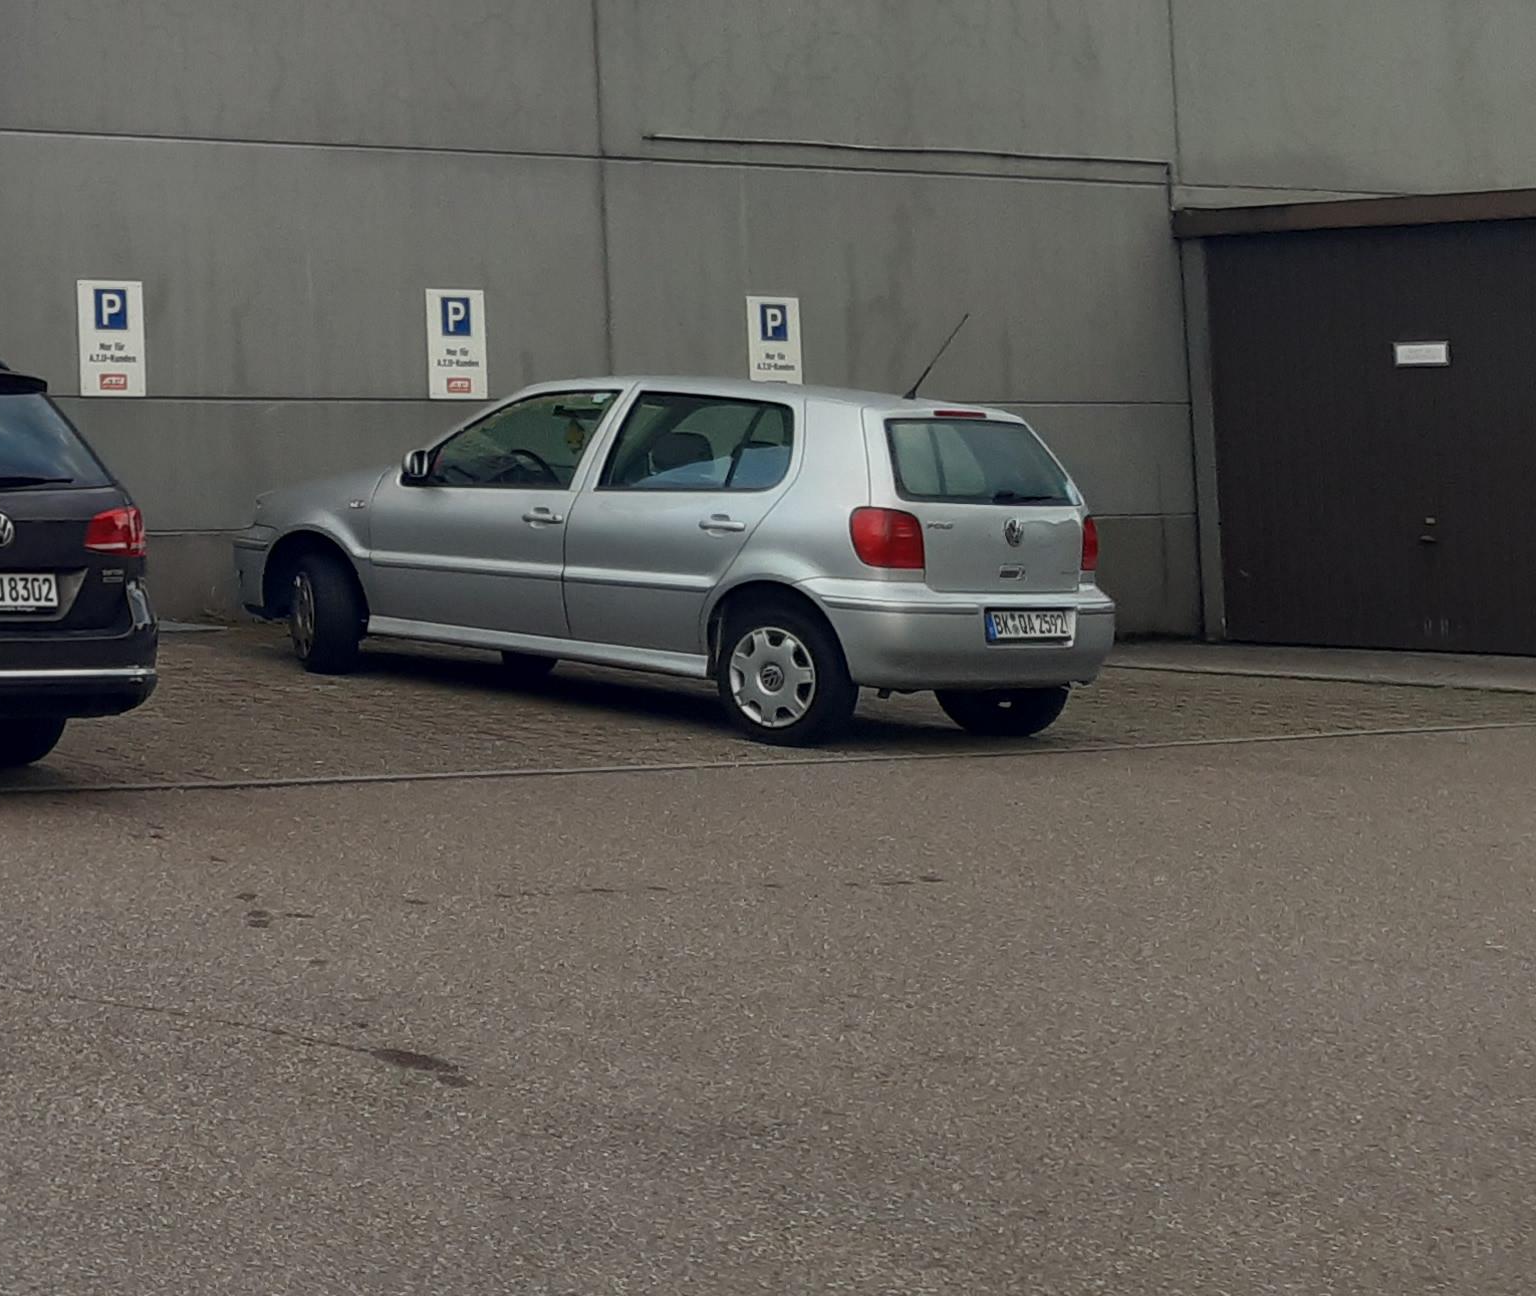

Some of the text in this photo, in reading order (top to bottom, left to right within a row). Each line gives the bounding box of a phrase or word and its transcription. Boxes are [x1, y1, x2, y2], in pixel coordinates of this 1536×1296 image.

[102, 293, 122, 325] P
[448, 301, 465, 332] P
[766, 308, 782, 337] P
[8, 577, 54, 603] 8302
[993, 614, 1067, 635] BK QA 2592
